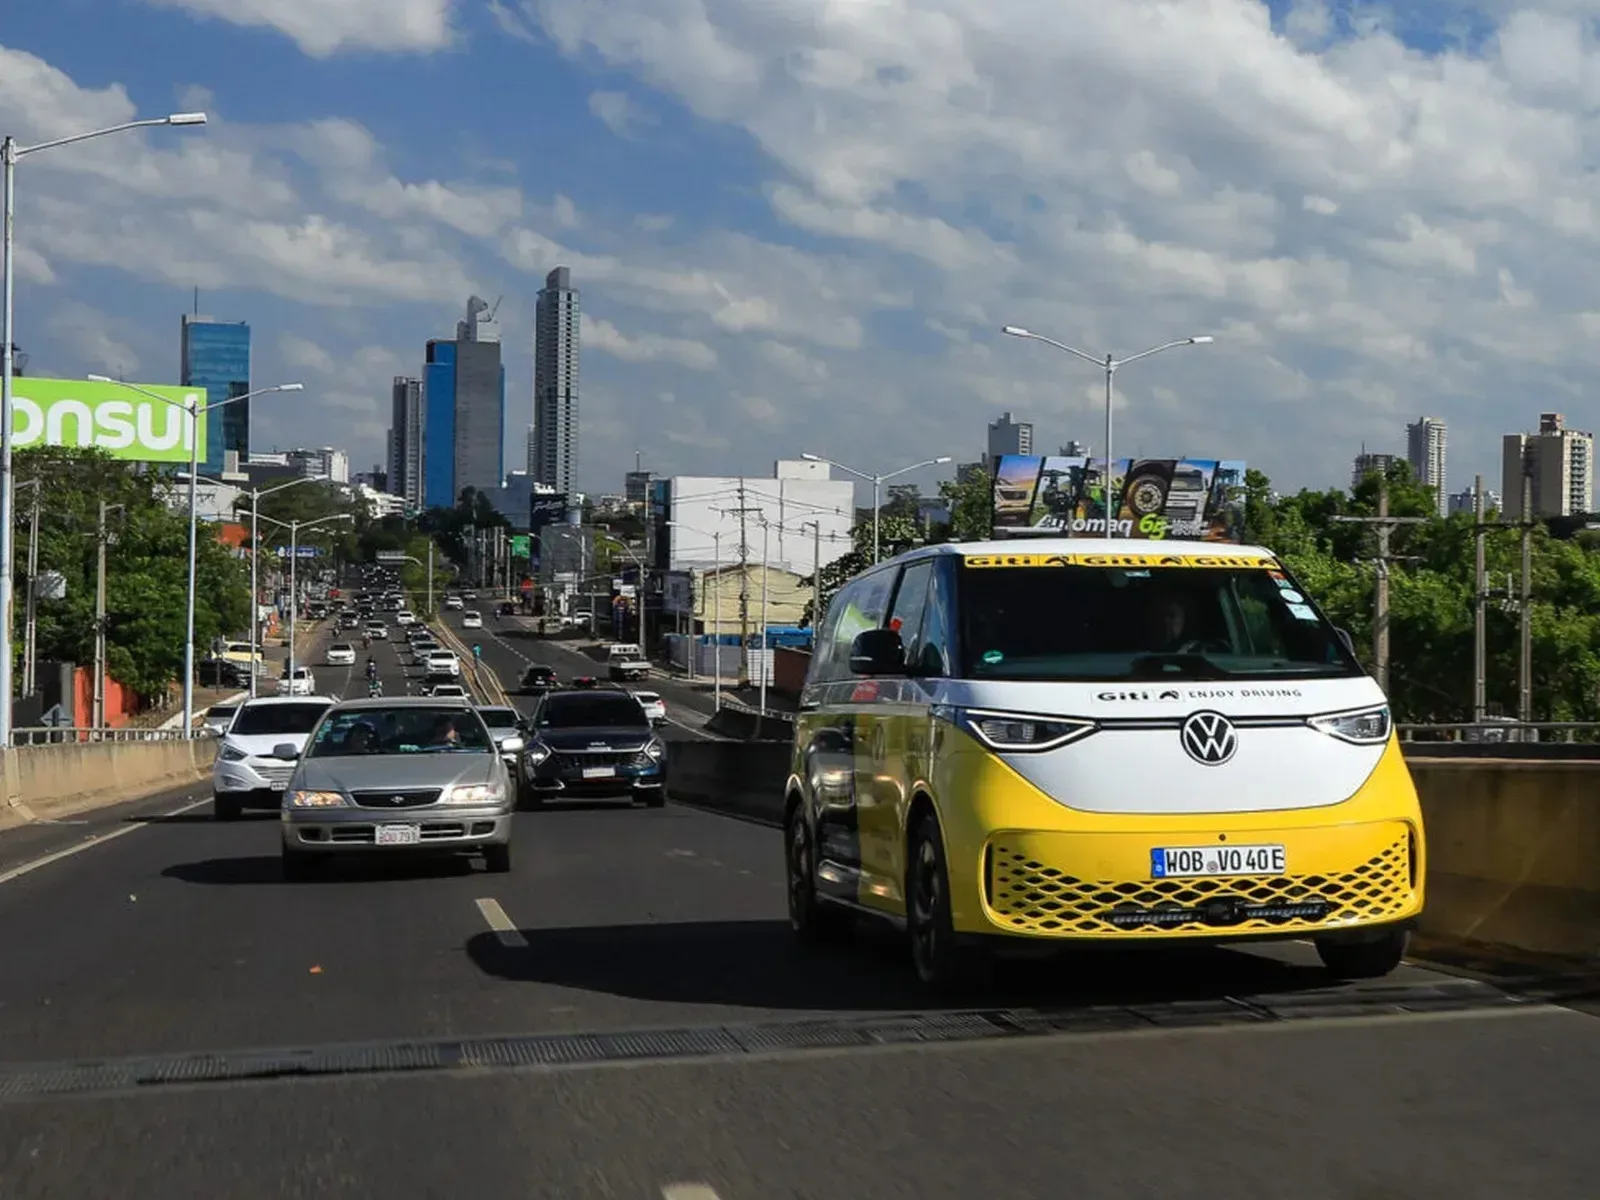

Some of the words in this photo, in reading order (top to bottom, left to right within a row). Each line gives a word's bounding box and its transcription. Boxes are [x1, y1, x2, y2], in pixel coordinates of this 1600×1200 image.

[1097, 690, 1148, 701] Giti
[1189, 689, 1235, 698] ENJOY
[1241, 688, 1303, 697] DRIVING
[1166, 850, 1203, 872] WOB
